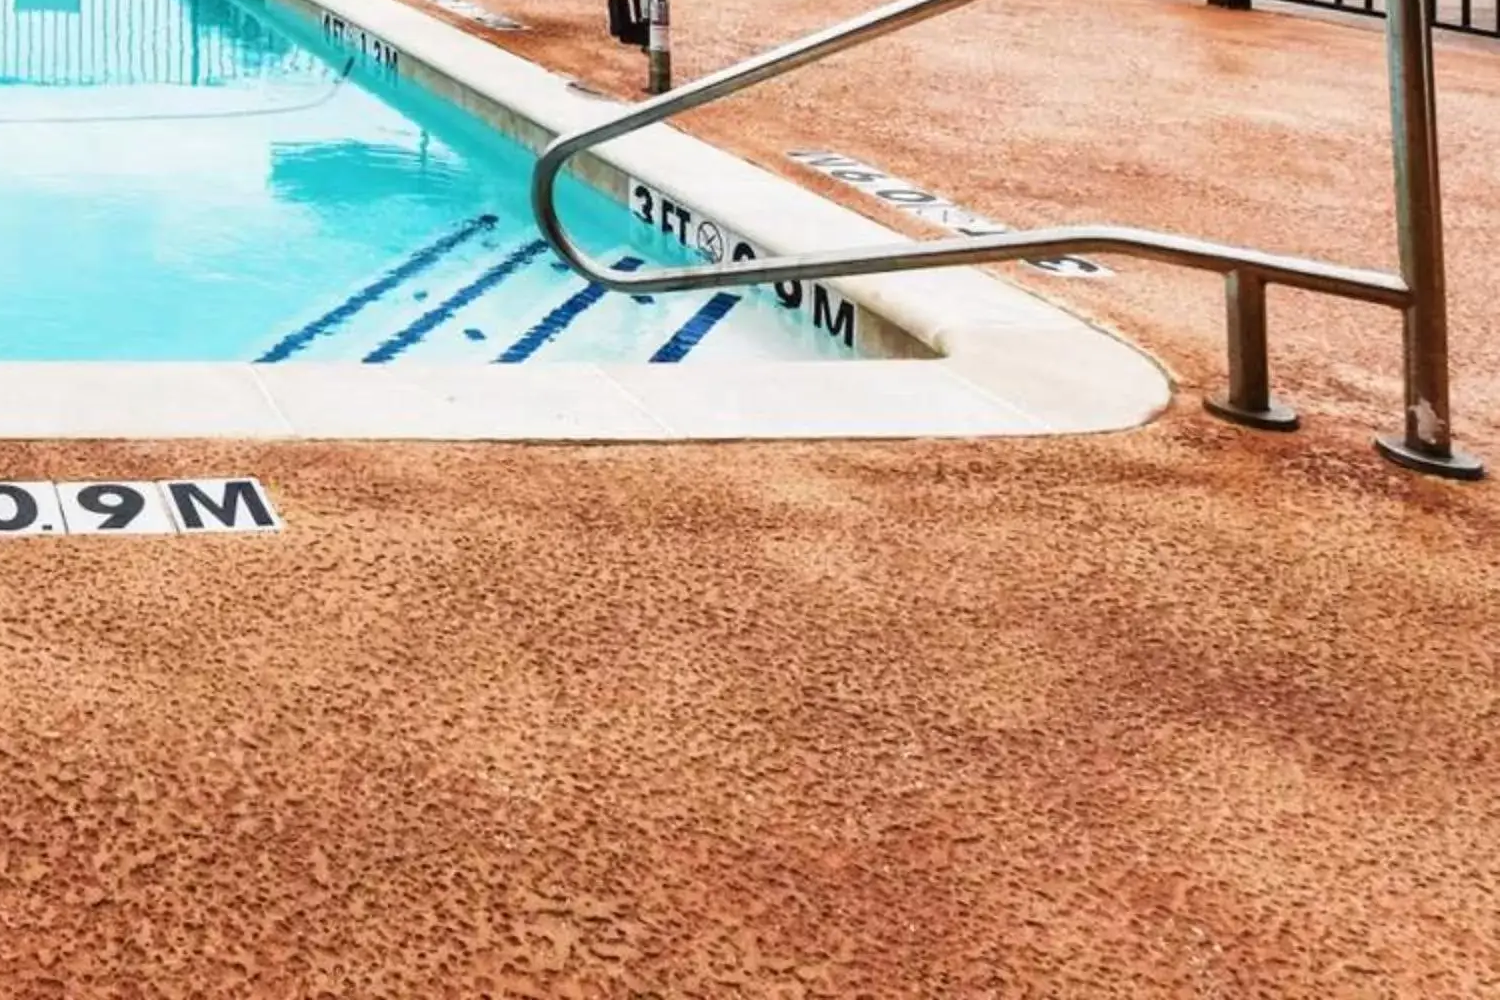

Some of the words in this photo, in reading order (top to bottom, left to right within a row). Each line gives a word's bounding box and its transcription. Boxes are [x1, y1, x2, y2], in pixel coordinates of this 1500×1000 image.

[634, 185, 654, 226] 3
[813, 283, 855, 348] M
[168, 481, 275, 529] M
